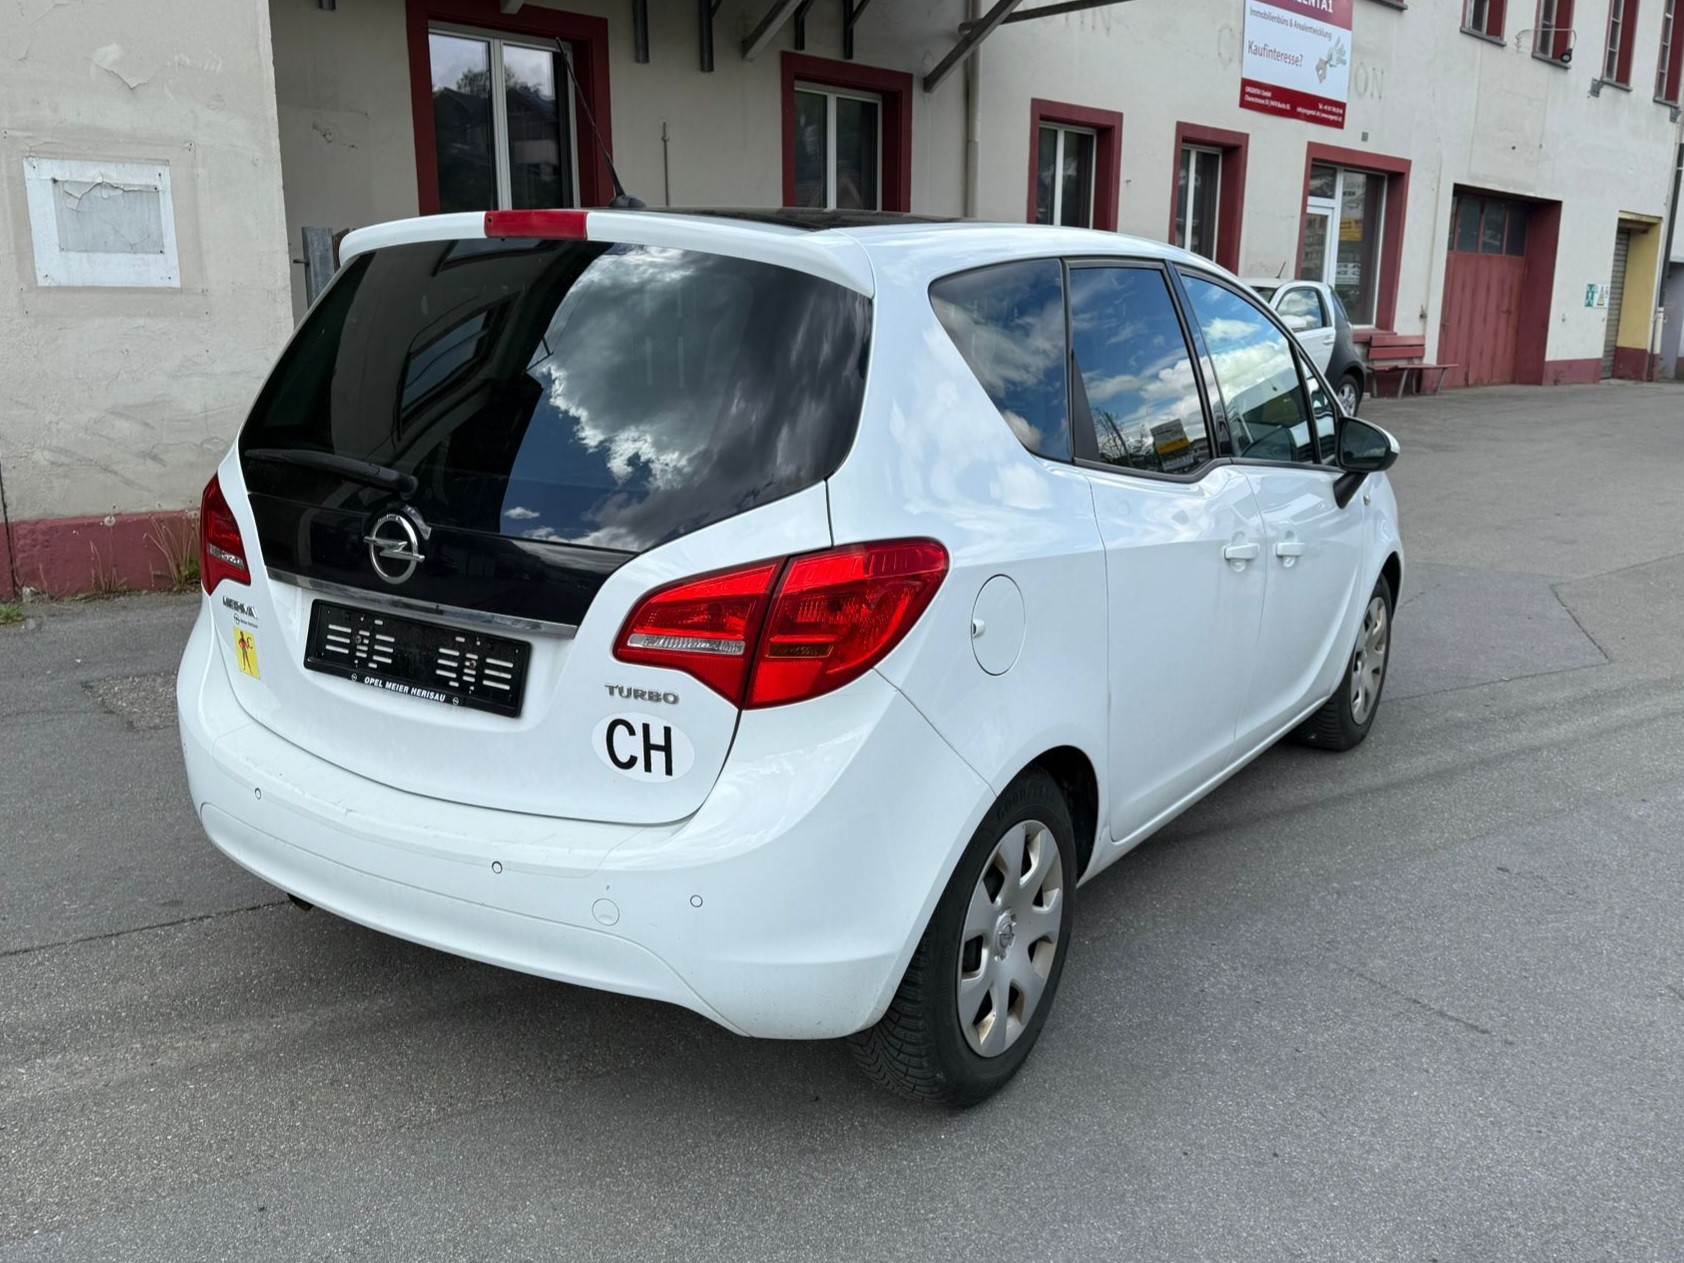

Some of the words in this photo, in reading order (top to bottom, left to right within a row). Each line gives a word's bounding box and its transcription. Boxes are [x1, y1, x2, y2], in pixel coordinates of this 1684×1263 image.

[1296, 0, 1334, 13] NTA1
[1247, 40, 1304, 67] Kaufinteresse?
[364, 676, 383, 688] OPEL
[385, 680, 409, 694] MEIER
[410, 685, 446, 702] HERISAU
[604, 684, 680, 705] TURBO
[605, 718, 673, 777] CH
